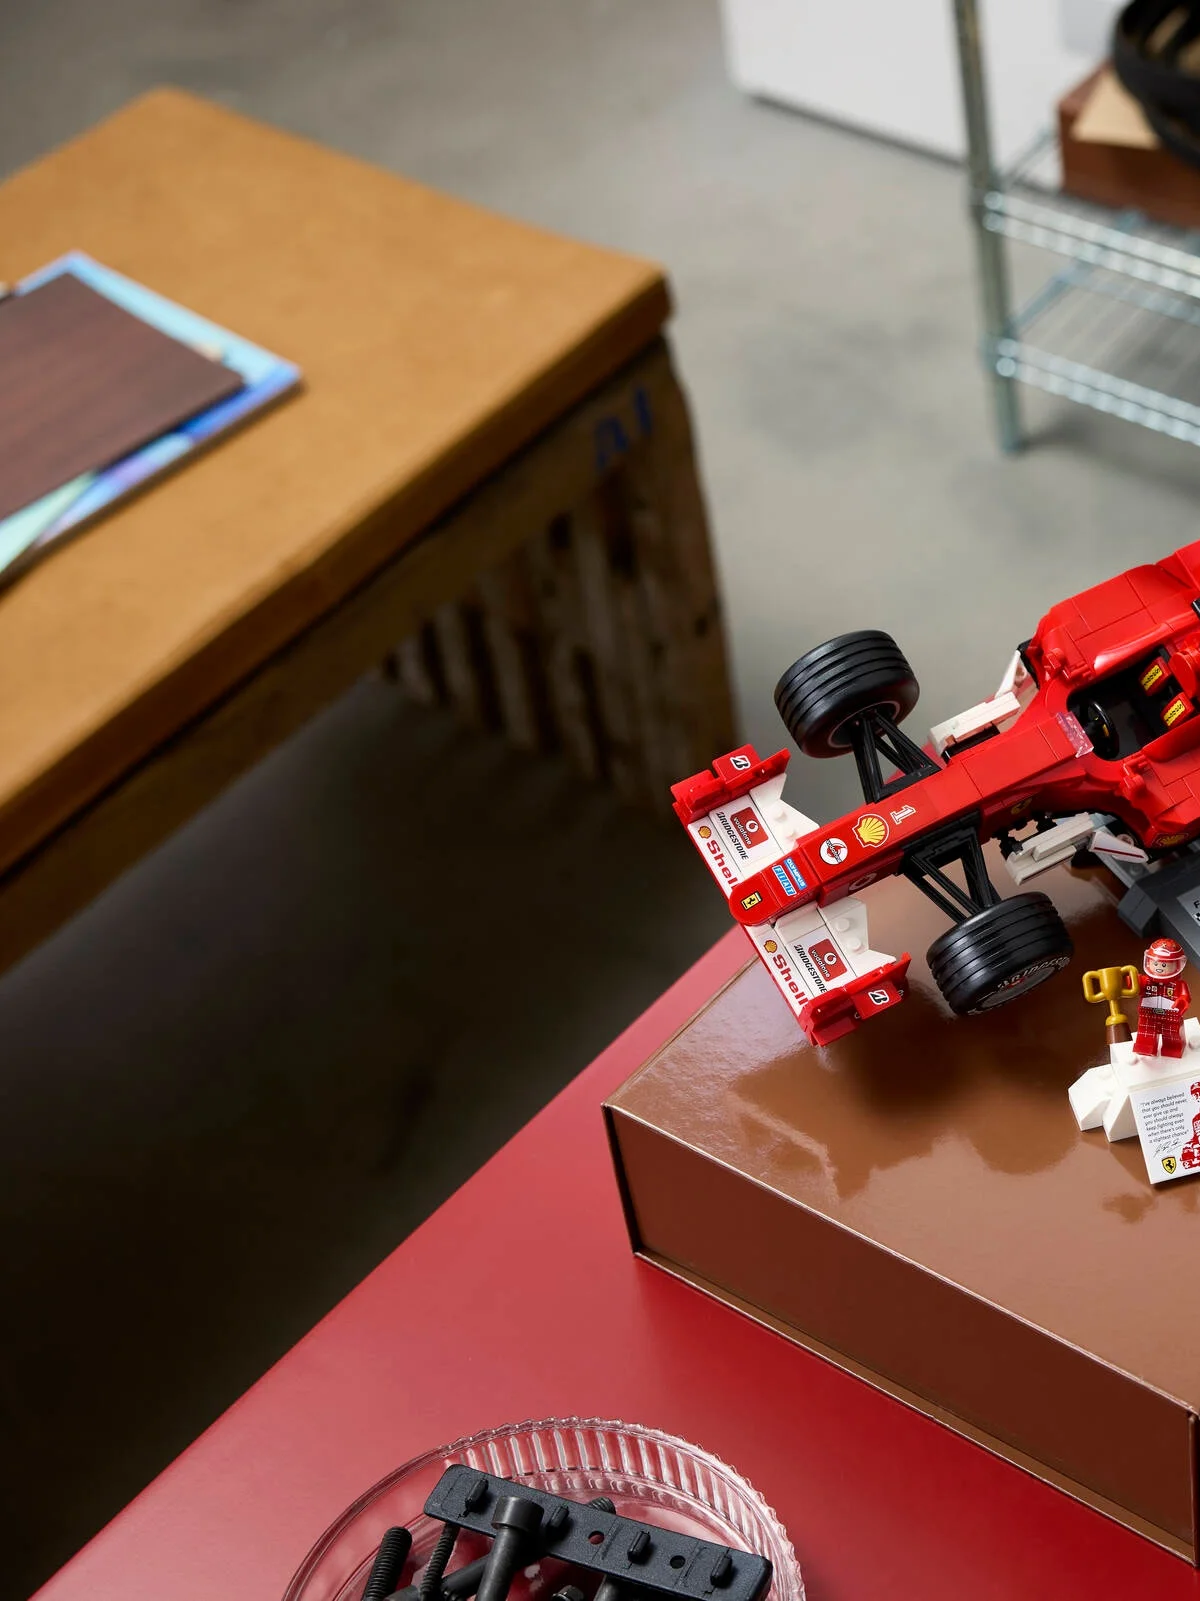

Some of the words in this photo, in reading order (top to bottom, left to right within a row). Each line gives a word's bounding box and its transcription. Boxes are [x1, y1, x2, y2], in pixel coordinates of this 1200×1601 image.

[890, 805, 916, 825] 1
[716, 811, 749, 861] BRIDGESTONE
[733, 817, 752, 846] vodafone
[707, 839, 740, 889] Shel
[786, 858, 806, 889] OLYMPUS
[774, 865, 796, 896] FIAT
[794, 944, 828, 993] BRIDGESTONE
[811, 949, 831, 978] vodafone
[772, 953, 809, 1006] Shell
